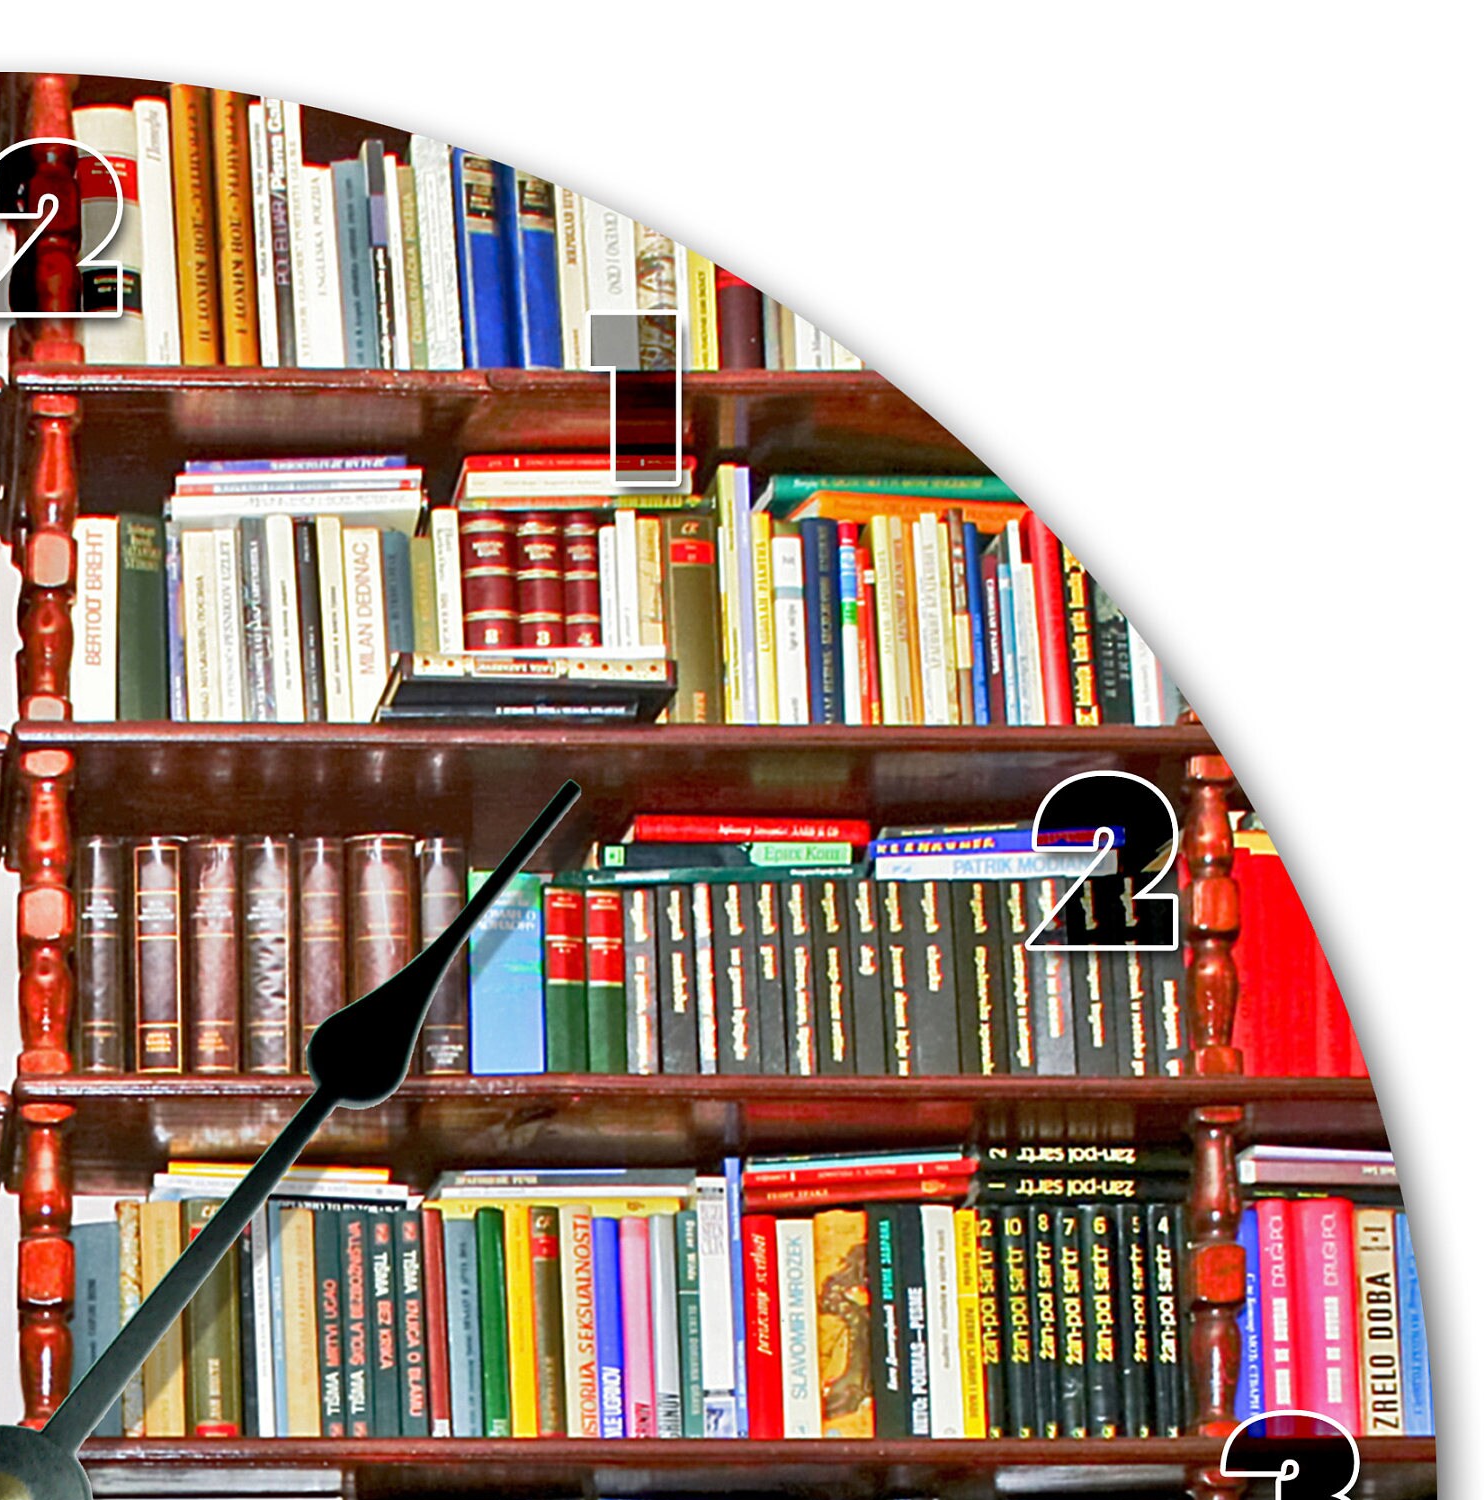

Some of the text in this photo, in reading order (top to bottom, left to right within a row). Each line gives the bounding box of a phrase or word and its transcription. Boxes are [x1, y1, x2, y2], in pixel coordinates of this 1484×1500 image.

[589, 309, 683, 486] 1
[85, 529, 104, 590] BREHT
[219, 540, 231, 580] UZLET
[353, 543, 375, 675] MILAN DEDINAC
[952, 857, 1016, 875] PATRIK
[1025, 770, 1179, 950] 2
[989, 1147, 1006, 1159] 2
[1017, 1178, 1134, 1196] žan-pol sartr
[1018, 1146, 1135, 1164] žan-pol sartr
[1004, 1218, 1022, 1236] 10
[1039, 1214, 1049, 1232] 8
[1062, 1218, 1075, 1235] 7
[1094, 1217, 1106, 1234] 6
[1159, 1217, 1169, 1234] 4
[373, 1252, 392, 1325] TIŠMA BEZ
[402, 1250, 418, 1294] TIŠMA
[978, 1250, 1000, 1364] žan-pol sartr
[1006, 1246, 1029, 1363] žan-pol sartr
[1035, 1242, 1056, 1360] žan-pol sartr
[1061, 1247, 1083, 1365] žan-pol sartr
[1090, 1244, 1113, 1362] žan-pol sartr
[1129, 1244, 1147, 1362] žan-pol sartr
[1156, 1245, 1176, 1364] žan-pol sartr
[323, 1279, 340, 1415] TIŠMA MRTVI UGAO
[349, 1322, 365, 1414] TIŠMA ŠKOLA
[572, 1213, 597, 1437] ISTORIJA SEKSUALNOSTI
[787, 1312, 807, 1400] SLAVOMIR
[1365, 1272, 1399, 1429] ZRELO DOBA
